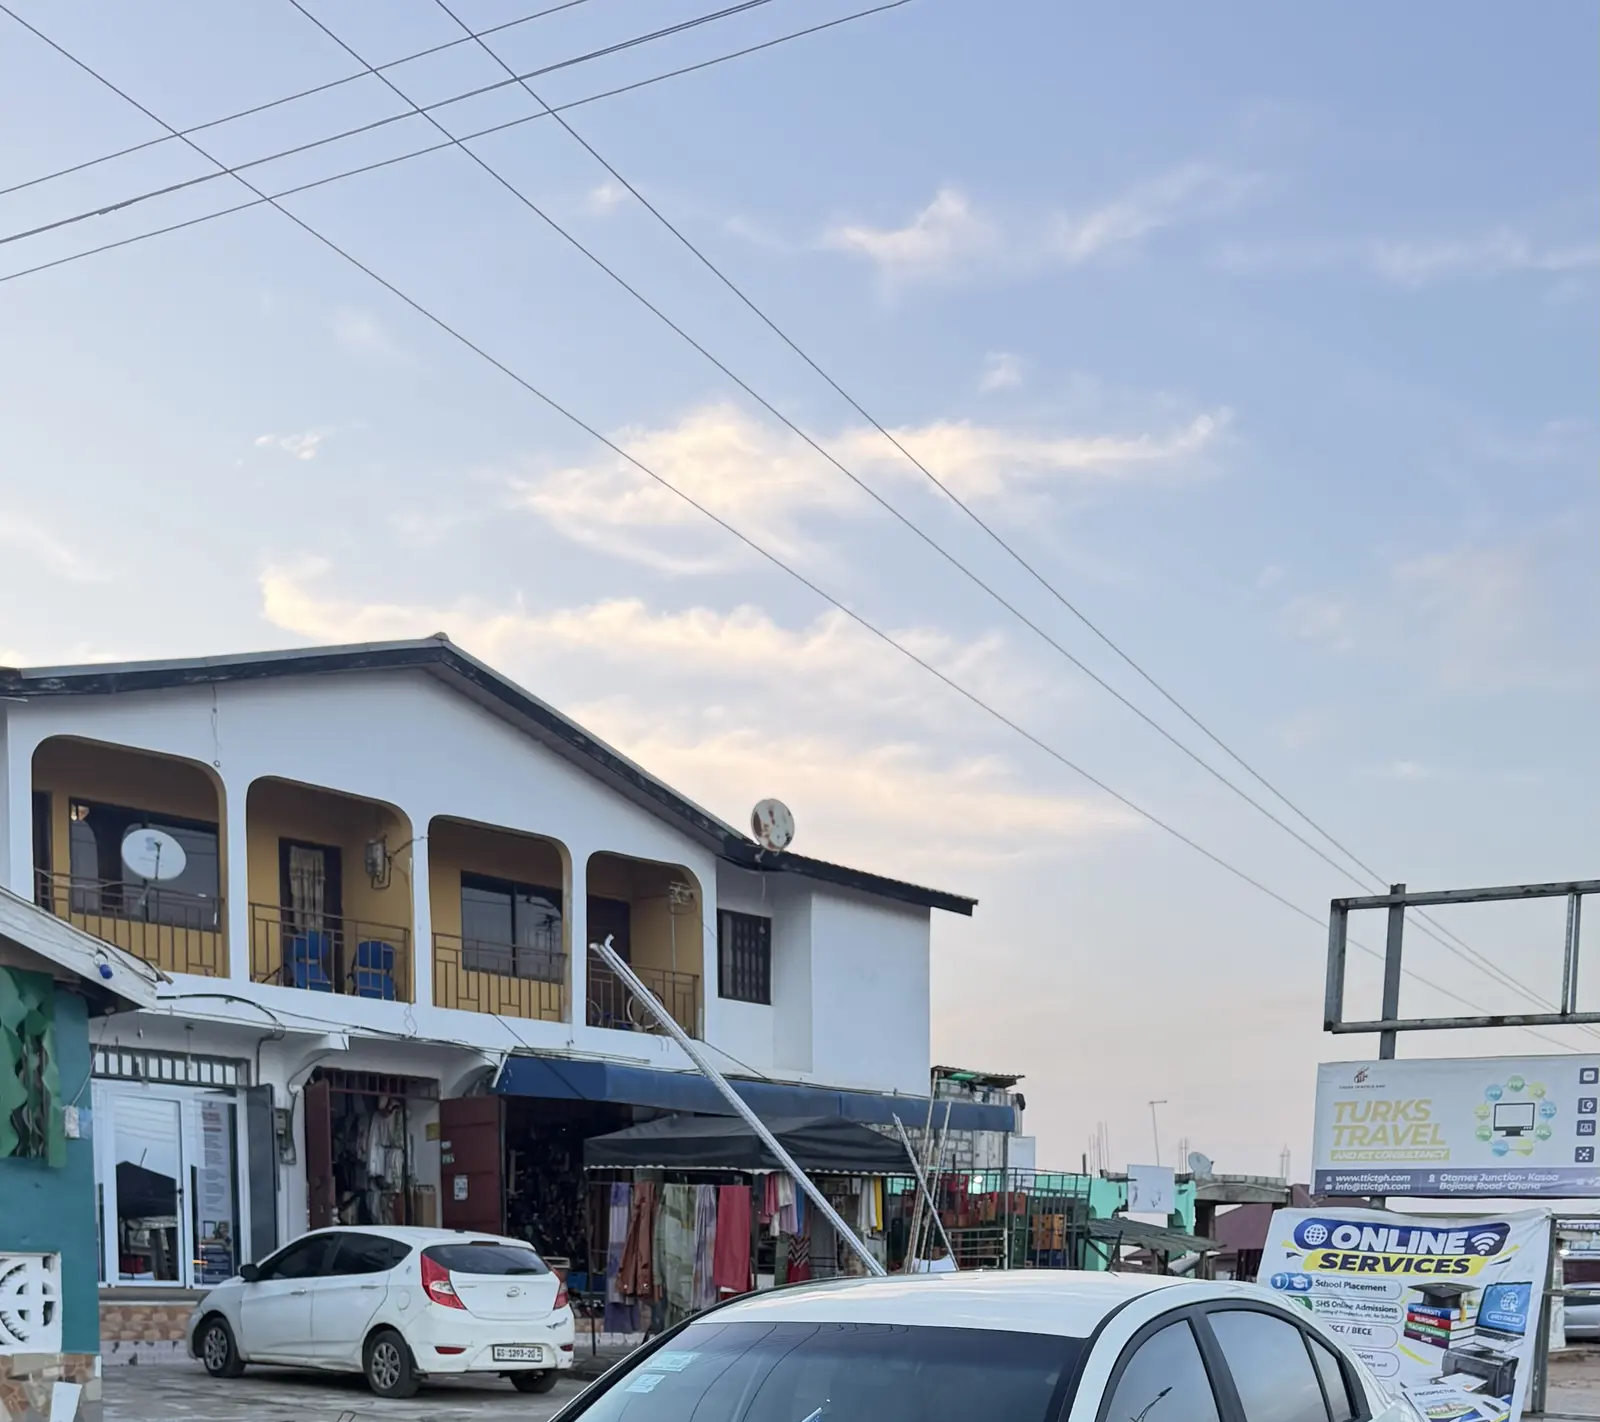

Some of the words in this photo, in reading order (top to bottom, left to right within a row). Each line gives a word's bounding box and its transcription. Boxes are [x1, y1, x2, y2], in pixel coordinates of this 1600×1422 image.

[1333, 1099, 1433, 1123] TURKS
[1331, 1122, 1446, 1147] TRAVEL
[1331, 1224, 1469, 1255] ONLINE
[1318, 1252, 1471, 1275] SERVICES
[1315, 1279, 1342, 1289] School
[1343, 1281, 1387, 1292] Placement
[1315, 1299, 1330, 1308] SHS
[1331, 1300, 1354, 1310] Online
[1355, 1303, 1398, 1314] Admissions
[1351, 1327, 1373, 1336] BECE
